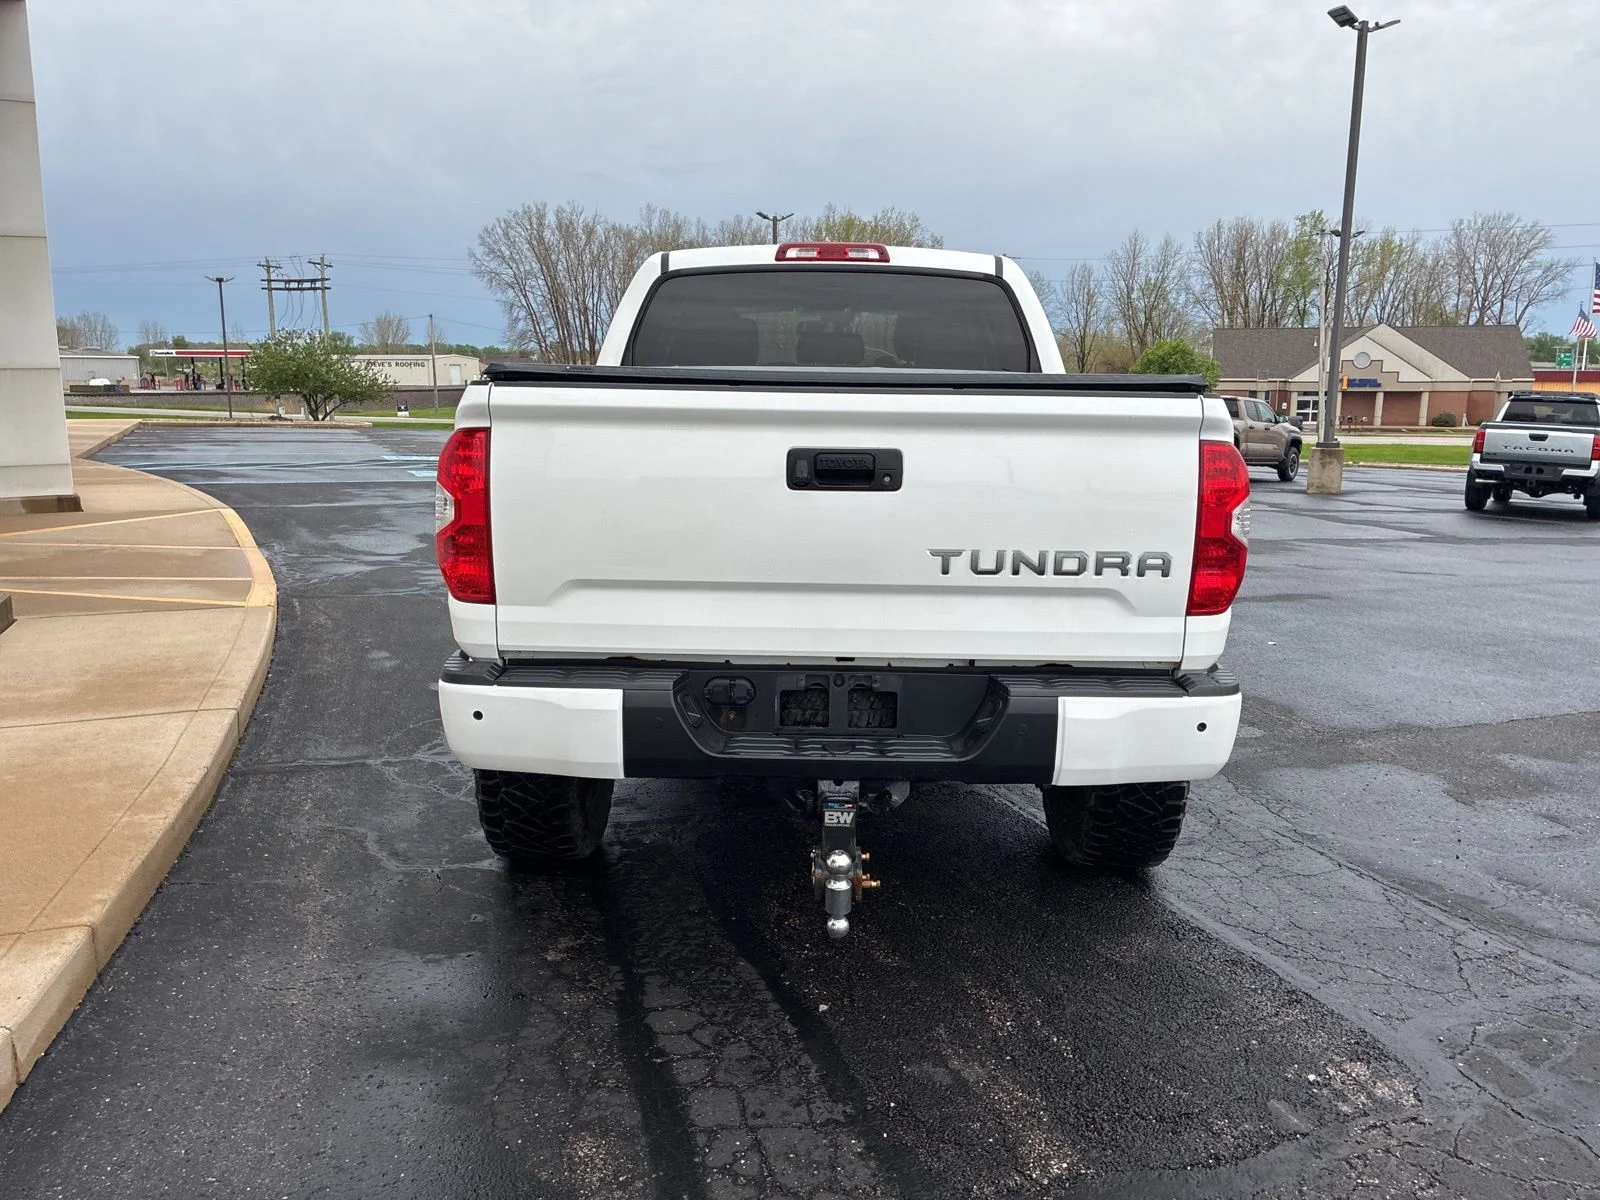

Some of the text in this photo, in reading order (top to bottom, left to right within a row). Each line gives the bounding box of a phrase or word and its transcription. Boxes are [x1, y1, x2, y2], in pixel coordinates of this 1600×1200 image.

[1502, 445, 1574, 454] TACOMA
[819, 457, 871, 469] TOYOTA
[928, 549, 1173, 578] TUNDRA
